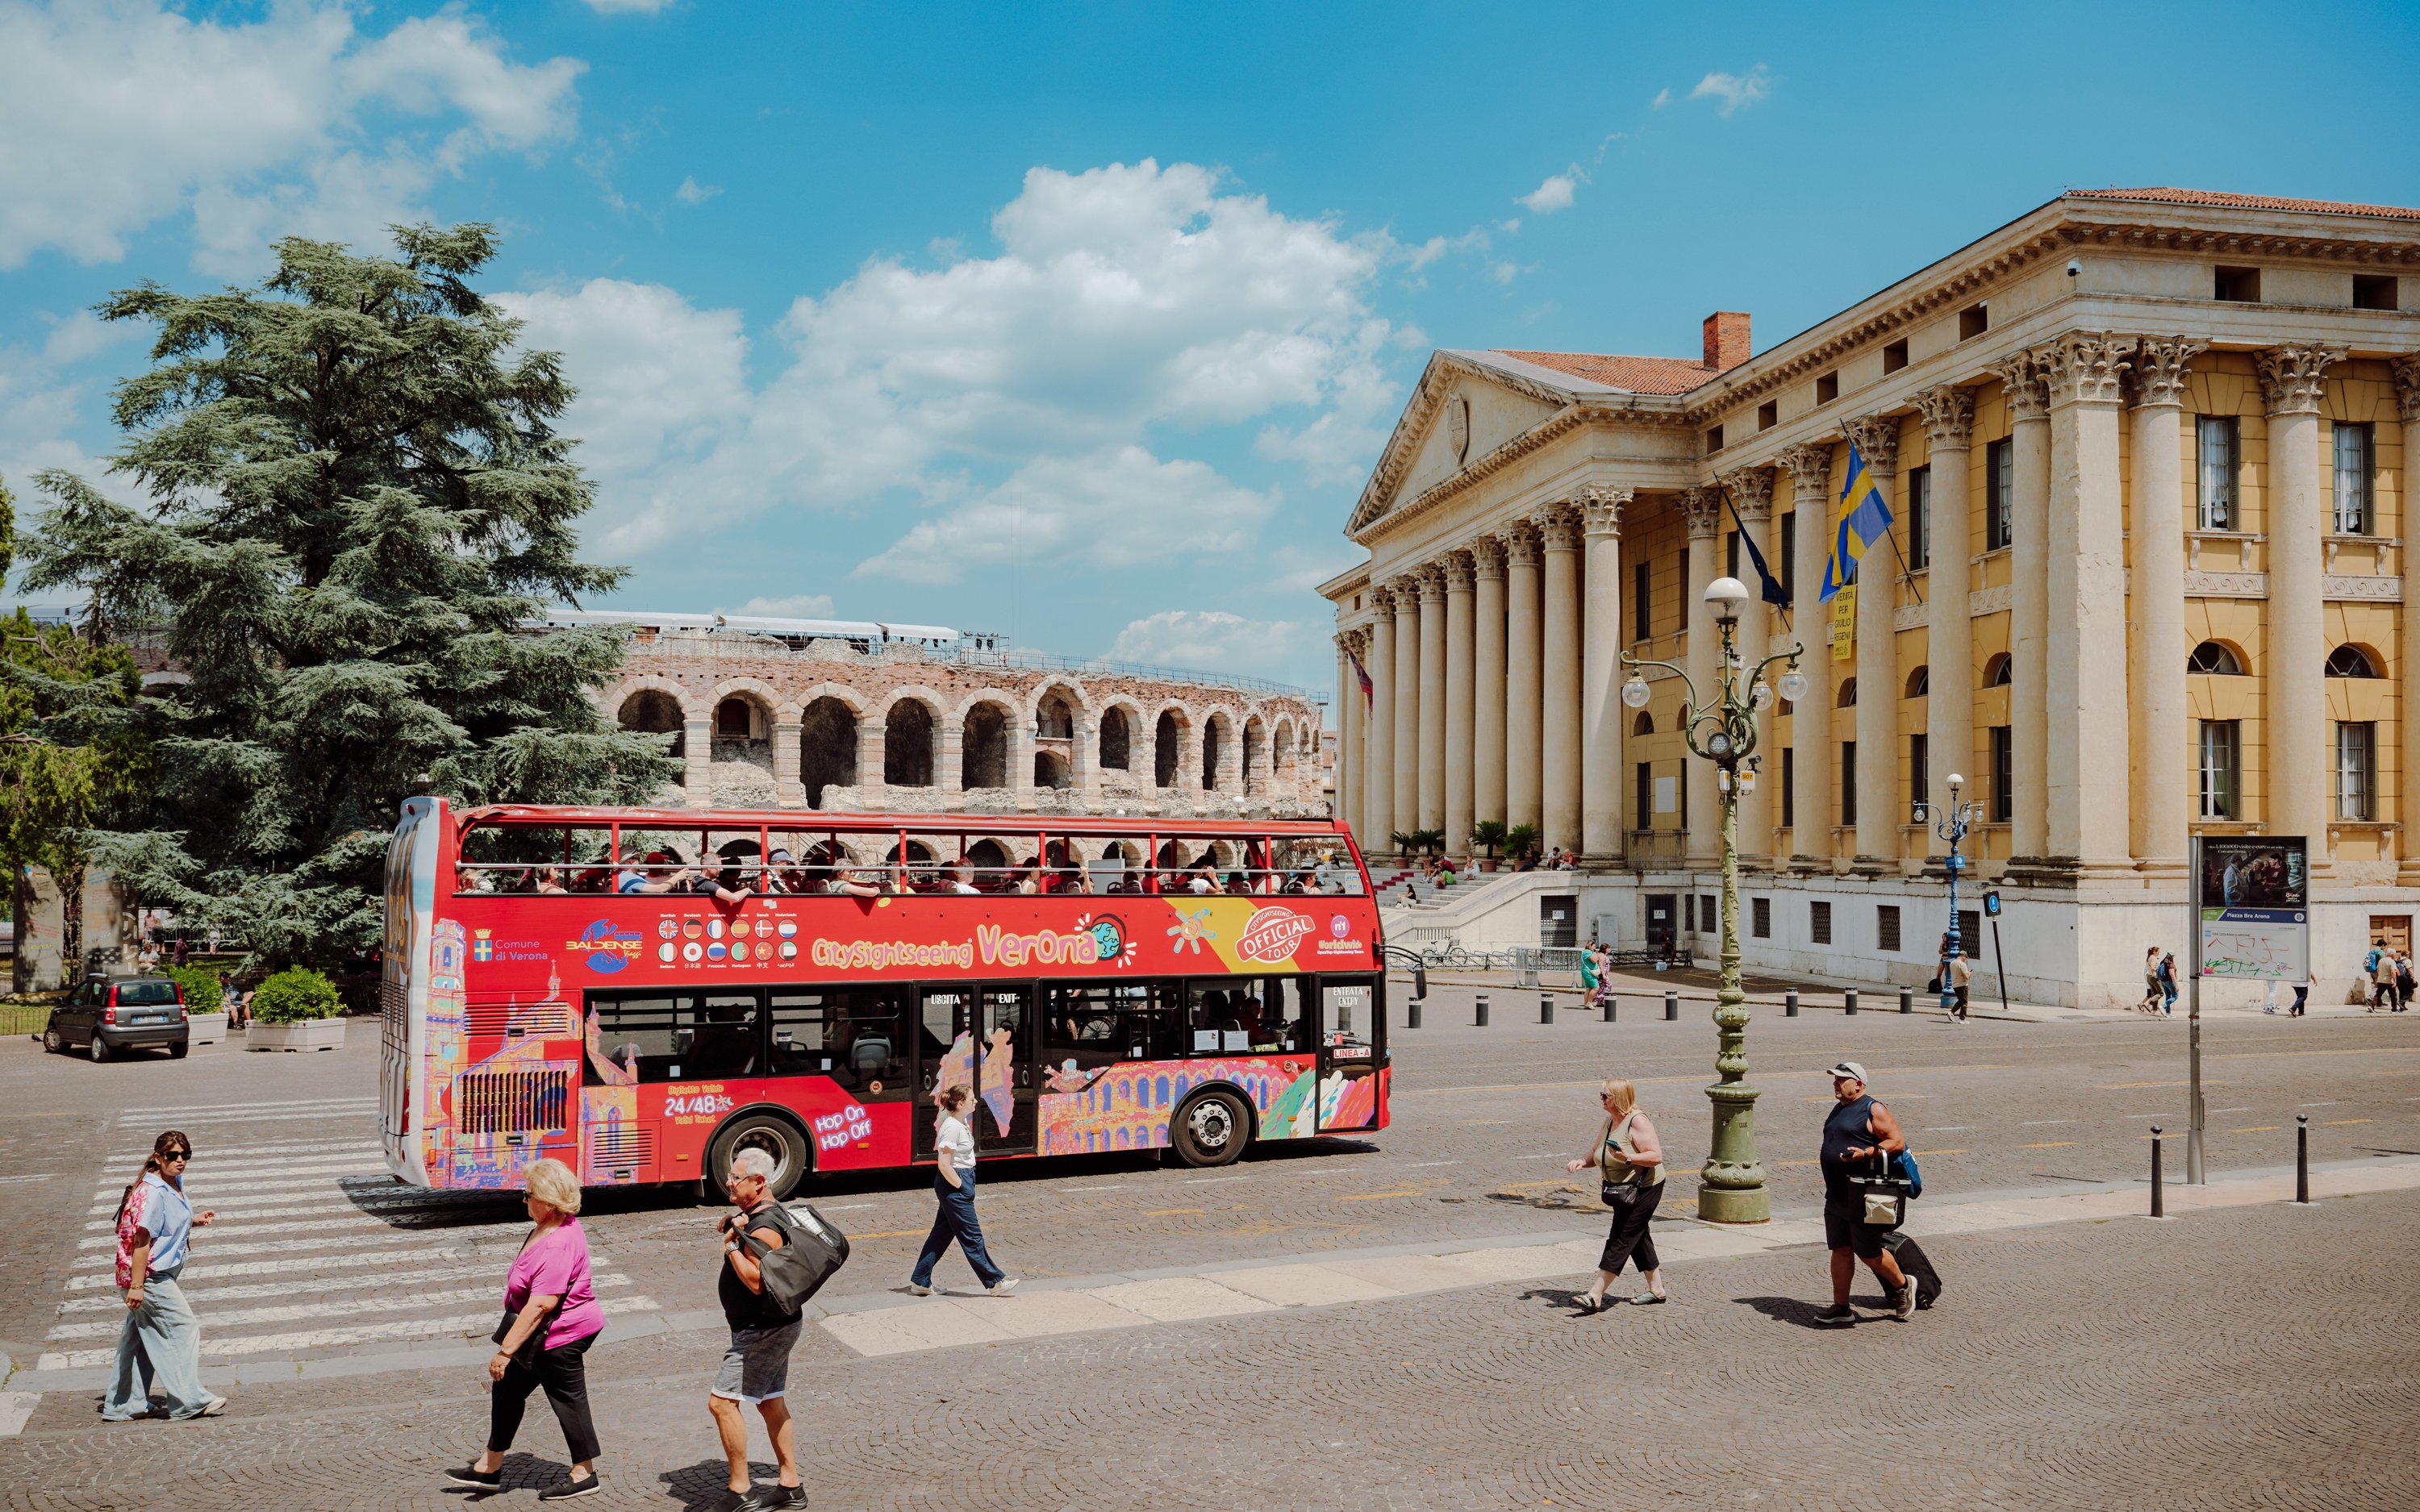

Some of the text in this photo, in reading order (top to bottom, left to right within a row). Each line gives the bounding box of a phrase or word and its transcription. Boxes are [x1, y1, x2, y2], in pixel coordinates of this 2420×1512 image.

[1838, 606, 1848, 614] PER
[1250, 910, 1290, 931] CITYSIGHTSEEING
[1243, 918, 1311, 955] OFFICIAL
[494, 939, 540, 949] Comune
[566, 941, 642, 949] BALDENSE
[1318, 939, 1362, 949] Worldwide
[624, 950, 641, 959] Viaggi
[1267, 940, 1297, 959] TOUR
[495, 951, 548, 960] di Verona
[1333, 986, 1363, 996] ENTRATA
[931, 994, 961, 1005] USCITA
[999, 993, 1016, 1003] EXIT
[1338, 997, 1358, 1006] ENTRY
[1334, 1049, 1358, 1058] LINEA
[702, 1084, 724, 1093] Valido
[665, 1094, 716, 1117] 24/48
[674, 1114, 716, 1125] Valid Ticket
[815, 1105, 866, 1132] Hop On
[820, 1119, 871, 1152] Hop Off
